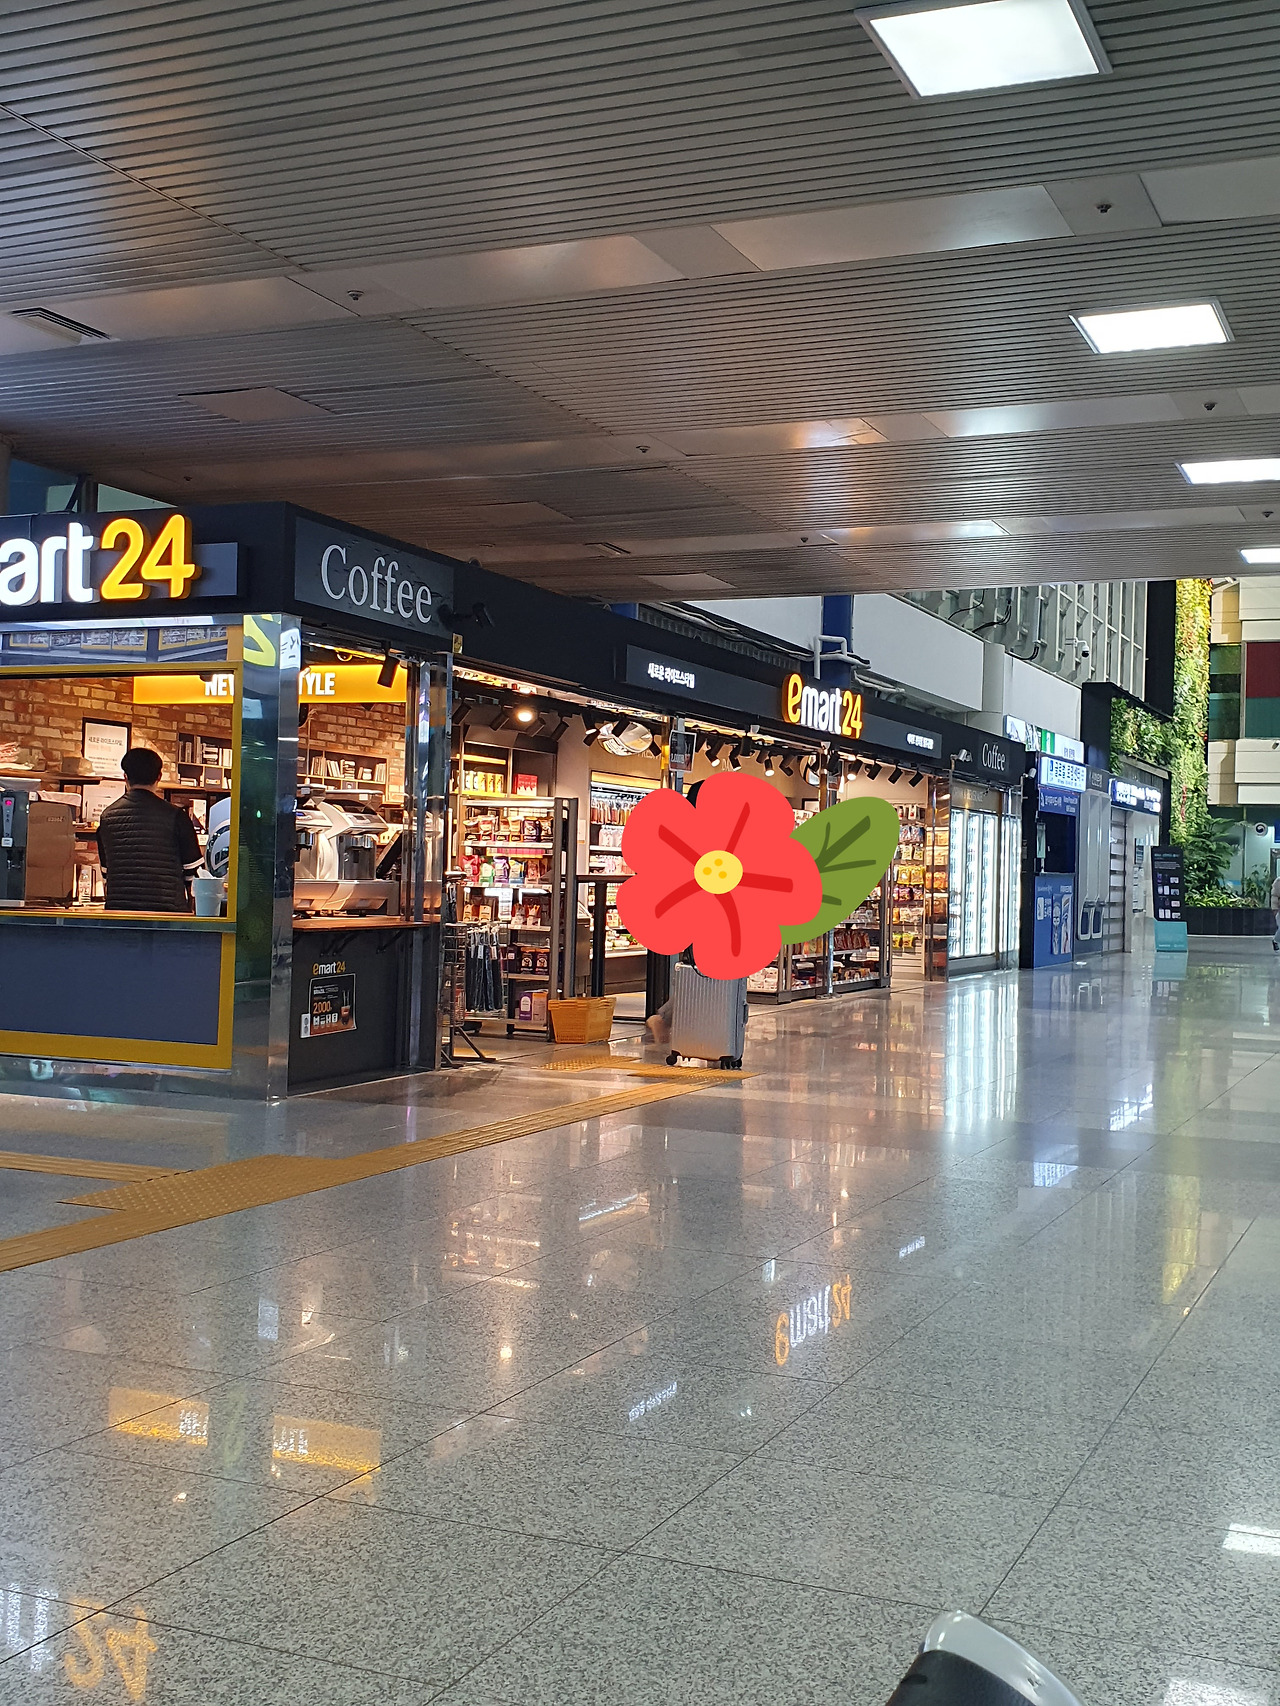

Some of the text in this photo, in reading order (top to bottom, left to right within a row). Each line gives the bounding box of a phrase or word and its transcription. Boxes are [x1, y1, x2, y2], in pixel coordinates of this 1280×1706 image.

[320, 544, 433, 624] Coffee
[647, 662, 695, 689] 새로운 라이프스타일
[784, 673, 864, 739] emart24
[982, 742, 1006, 772] Coffee
[312, 961, 346, 975] emart24
